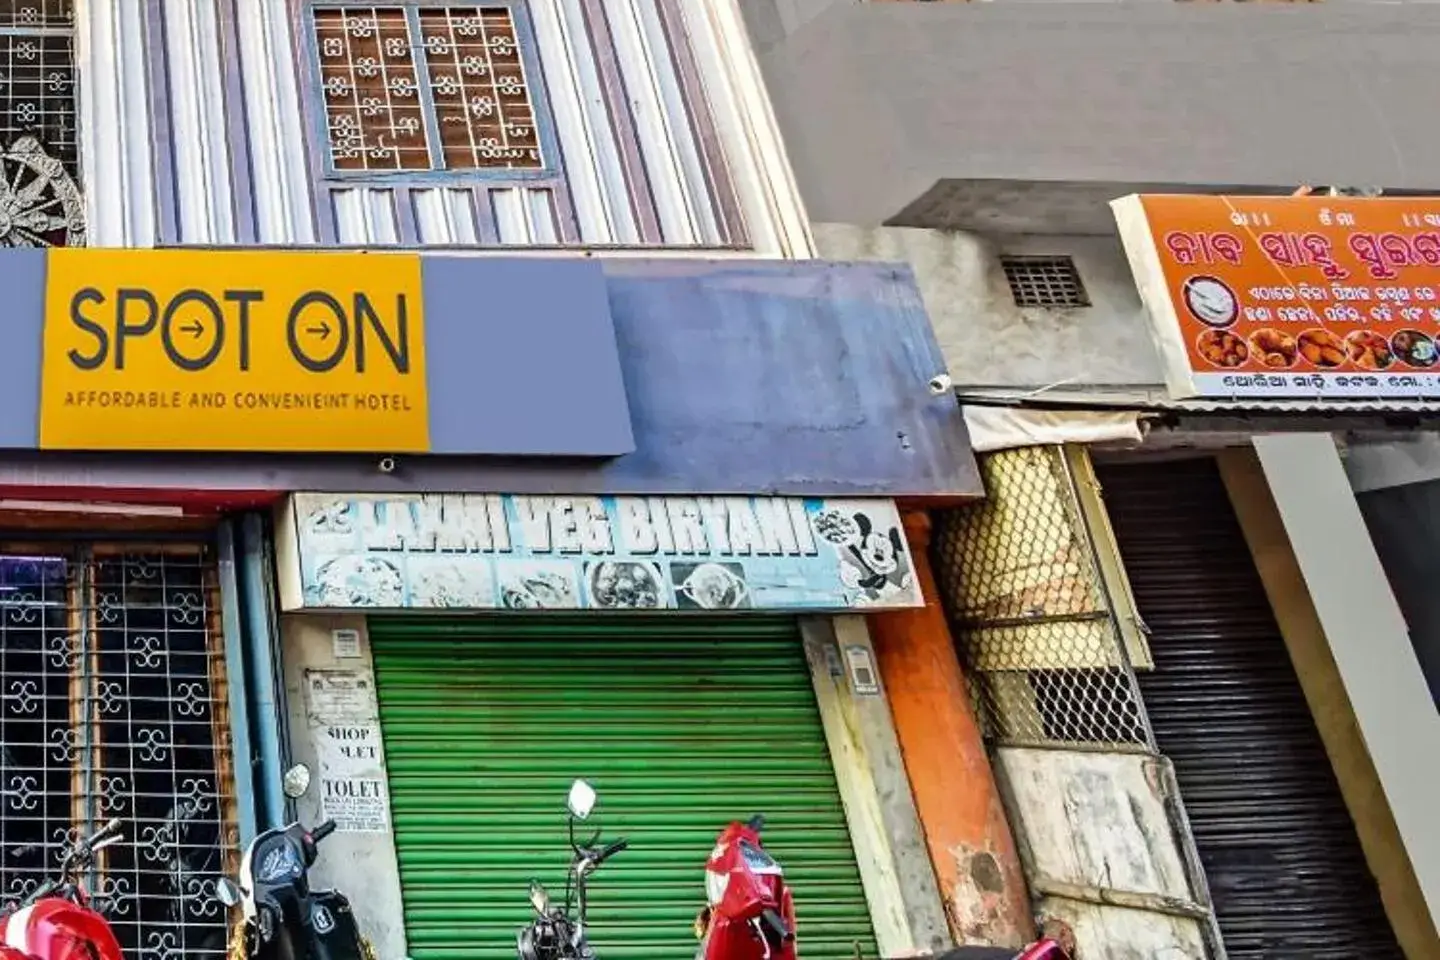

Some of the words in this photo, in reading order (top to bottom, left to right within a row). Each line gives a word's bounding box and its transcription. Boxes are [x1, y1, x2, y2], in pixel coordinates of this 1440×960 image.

[67, 287, 264, 372] SPOT
[286, 290, 410, 374] ON
[64, 391, 181, 408] AFFORDABLE
[188, 392, 226, 408] AND
[354, 394, 412, 411] HOTEL
[517, 495, 615, 555] VEG
[327, 727, 370, 740] SHOP
